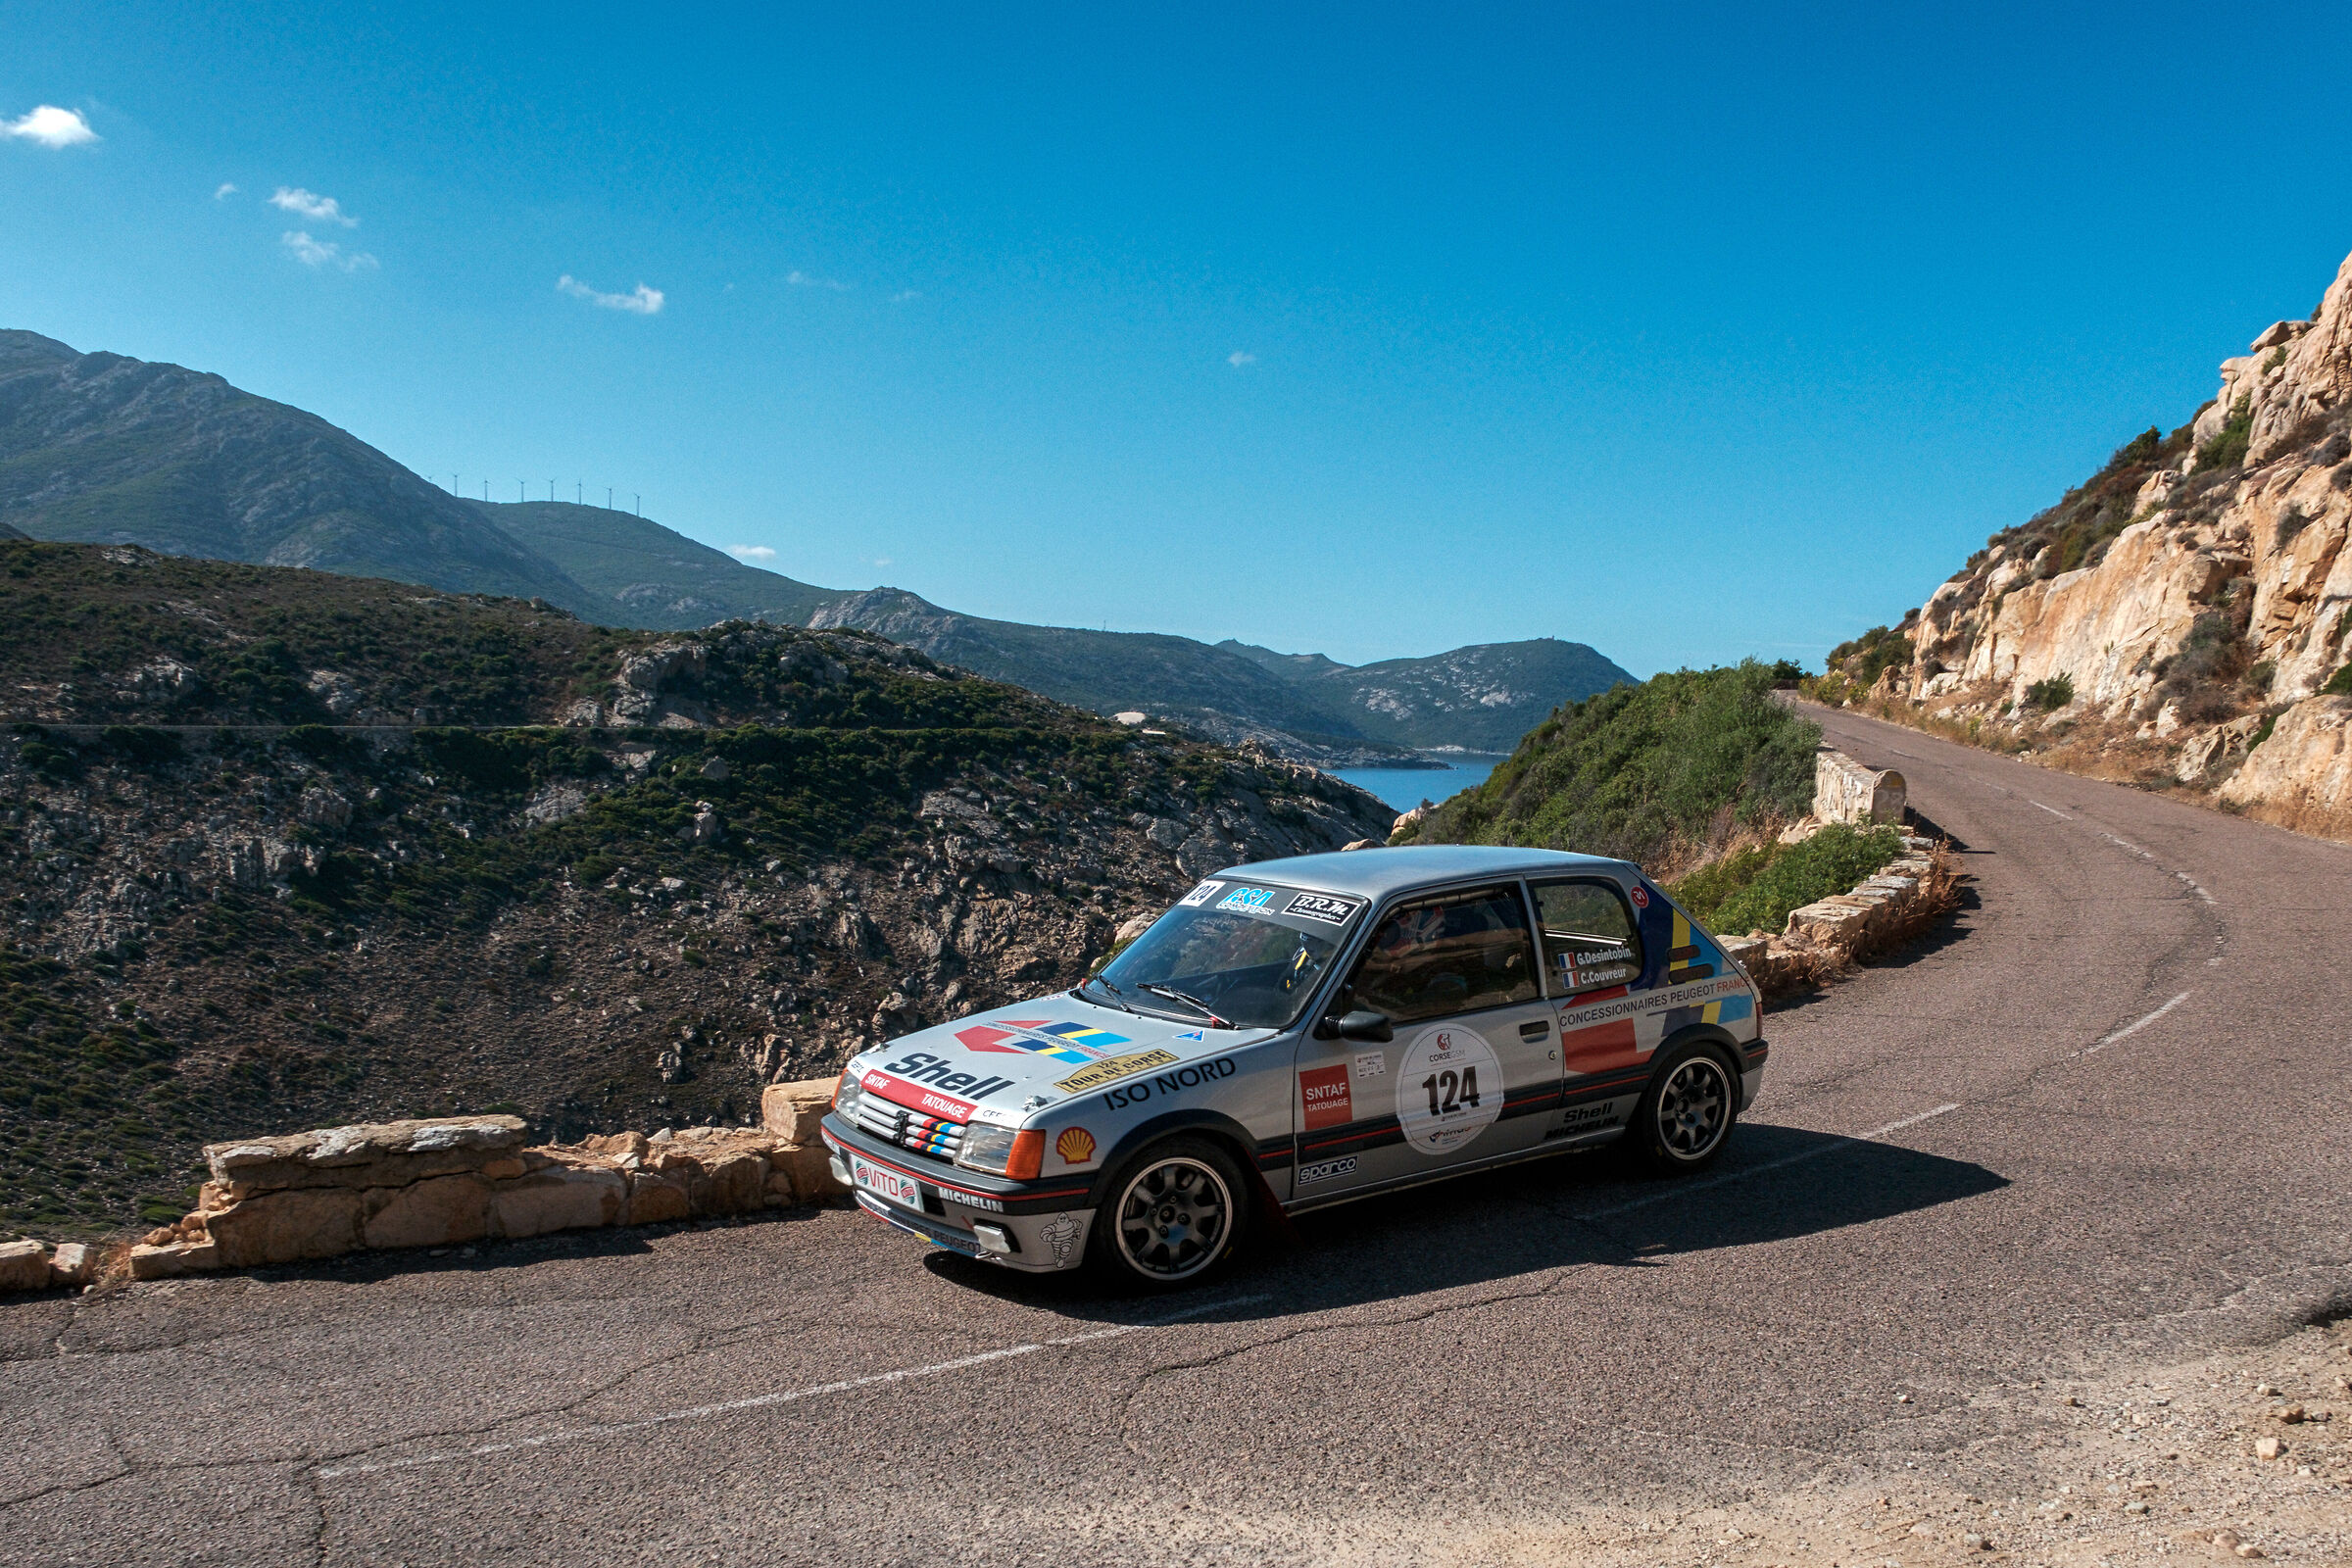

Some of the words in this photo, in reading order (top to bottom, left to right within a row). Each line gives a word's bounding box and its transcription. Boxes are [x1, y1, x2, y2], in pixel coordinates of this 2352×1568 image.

[1576, 946, 1632, 965] G.Desintobin
[1581, 966, 1627, 984] C.Couvreur
[1559, 995, 1668, 1027] CONCESSIONNAIRES
[1670, 983, 1716, 1003] PEUGEOT
[1060, 1073, 1102, 1089] TOUR
[1102, 1066, 1122, 1076] DE
[1123, 1051, 1169, 1069] CORSE
[1097, 1060, 1118, 1069] 124
[884, 1053, 1015, 1101] Shell
[1102, 1082, 1151, 1111] ISO
[1157, 1057, 1237, 1096] NORD
[865, 1074, 890, 1090] SNTAF
[921, 1094, 967, 1118] TATOUAGE
[1305, 1082, 1347, 1102] SNTAF
[1422, 1066, 1481, 1116] 124
[1307, 1098, 1348, 1112] TATOUAGE
[1563, 1102, 1614, 1123] Shell
[1299, 1158, 1357, 1184] sparco
[938, 1188, 1004, 1212] MICHELIN
[933, 1231, 981, 1253] PEUGEOT
